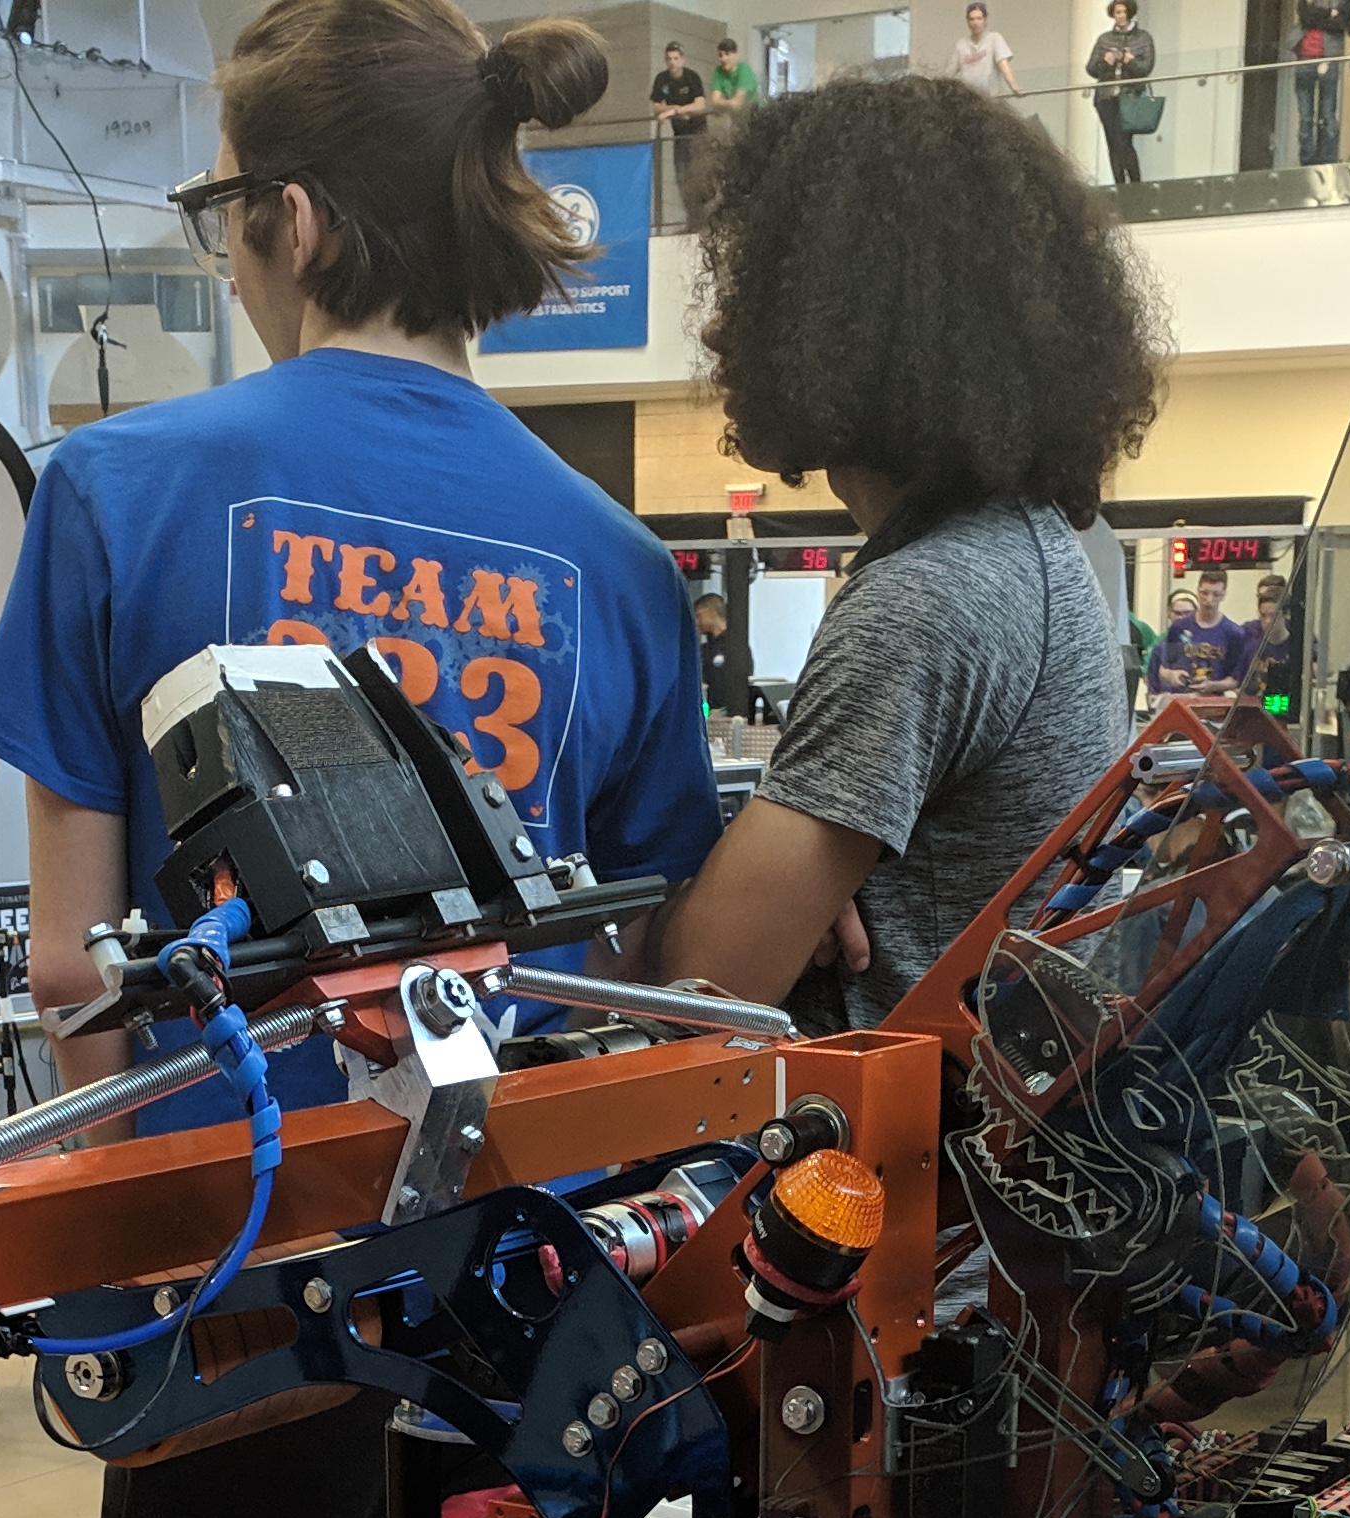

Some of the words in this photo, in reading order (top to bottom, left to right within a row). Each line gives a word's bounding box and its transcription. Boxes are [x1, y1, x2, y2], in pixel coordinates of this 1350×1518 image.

[580, 284, 630, 298] SUPPORT
[802, 548, 828, 569] 96
[1198, 538, 1259, 562] 3044
[273, 530, 545, 647] TEAM
